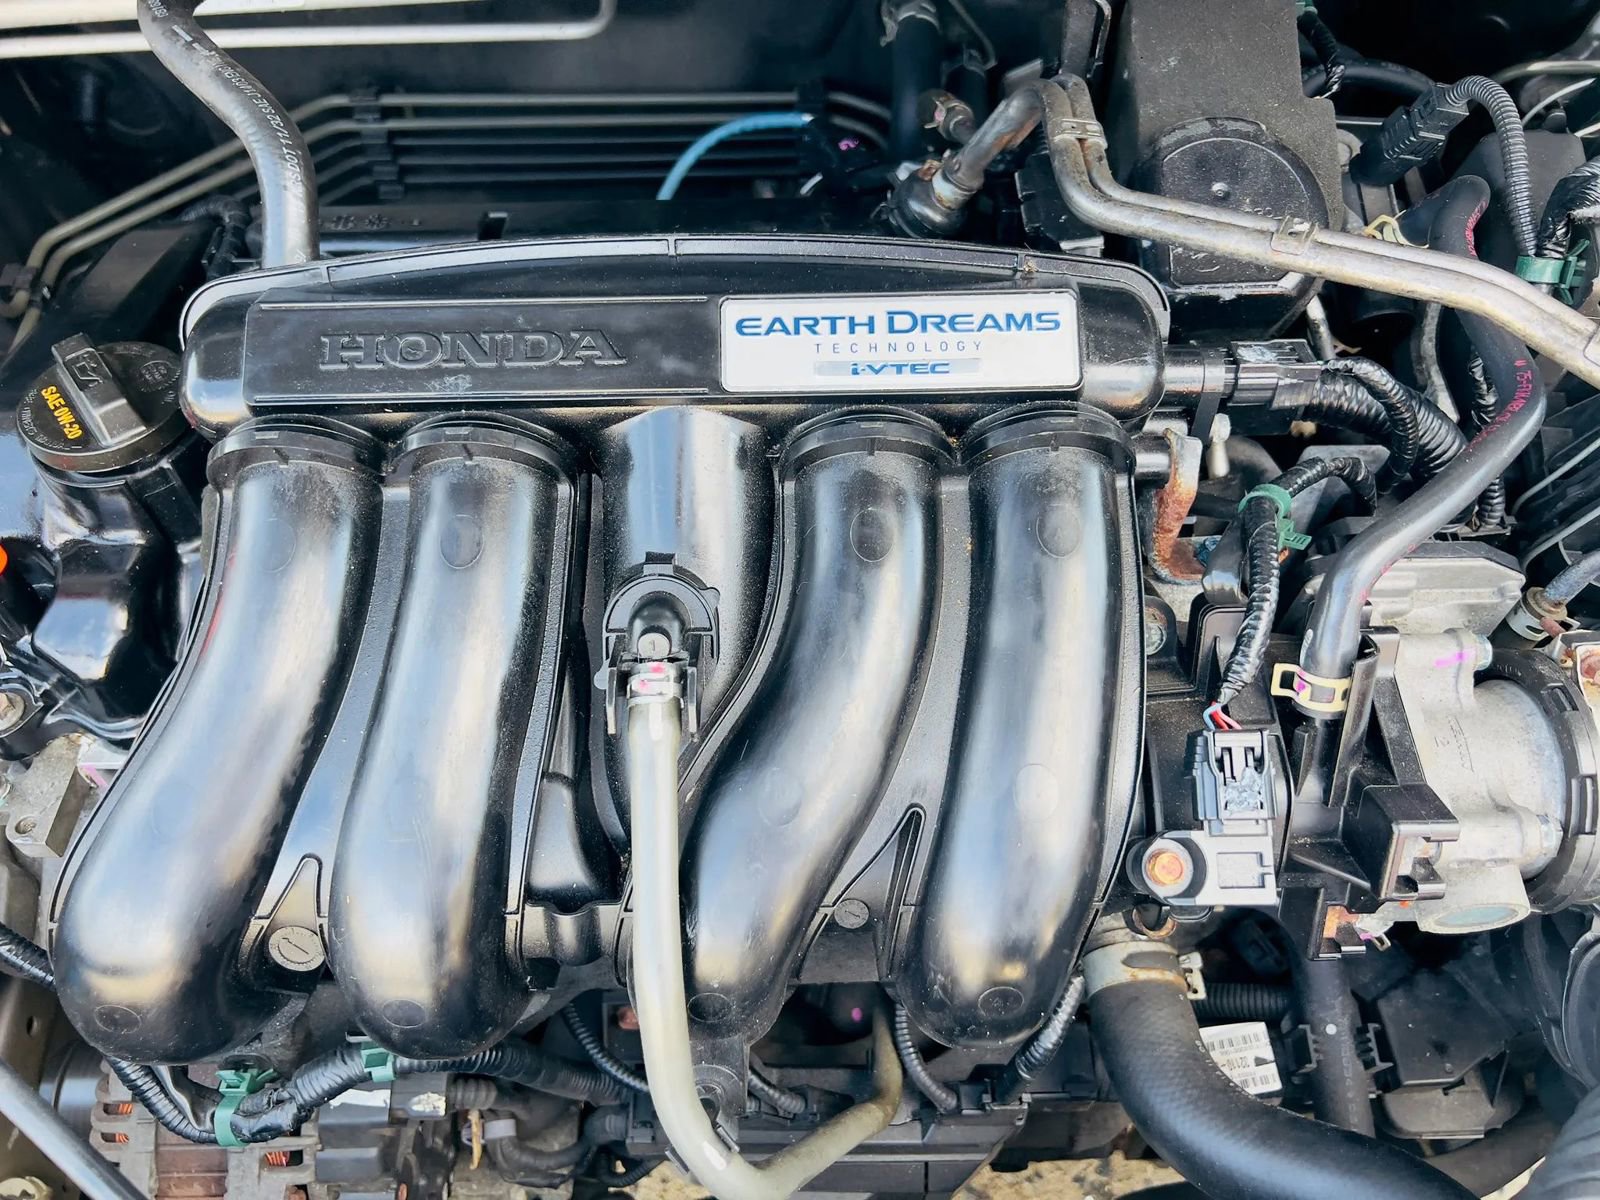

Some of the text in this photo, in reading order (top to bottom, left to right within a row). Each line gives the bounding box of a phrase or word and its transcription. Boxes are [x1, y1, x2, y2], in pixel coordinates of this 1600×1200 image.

[252, 97, 275, 116] SAE
[267, 115, 293, 146] 11/32
[283, 147, 300, 173] DOT
[735, 310, 1061, 337] EARTH DREAMS
[318, 330, 628, 370] HONDA
[815, 341, 982, 355] TECHNOLOGY
[850, 361, 950, 377] i-VTEC
[41, 386, 83, 440] SAE 0W-20
